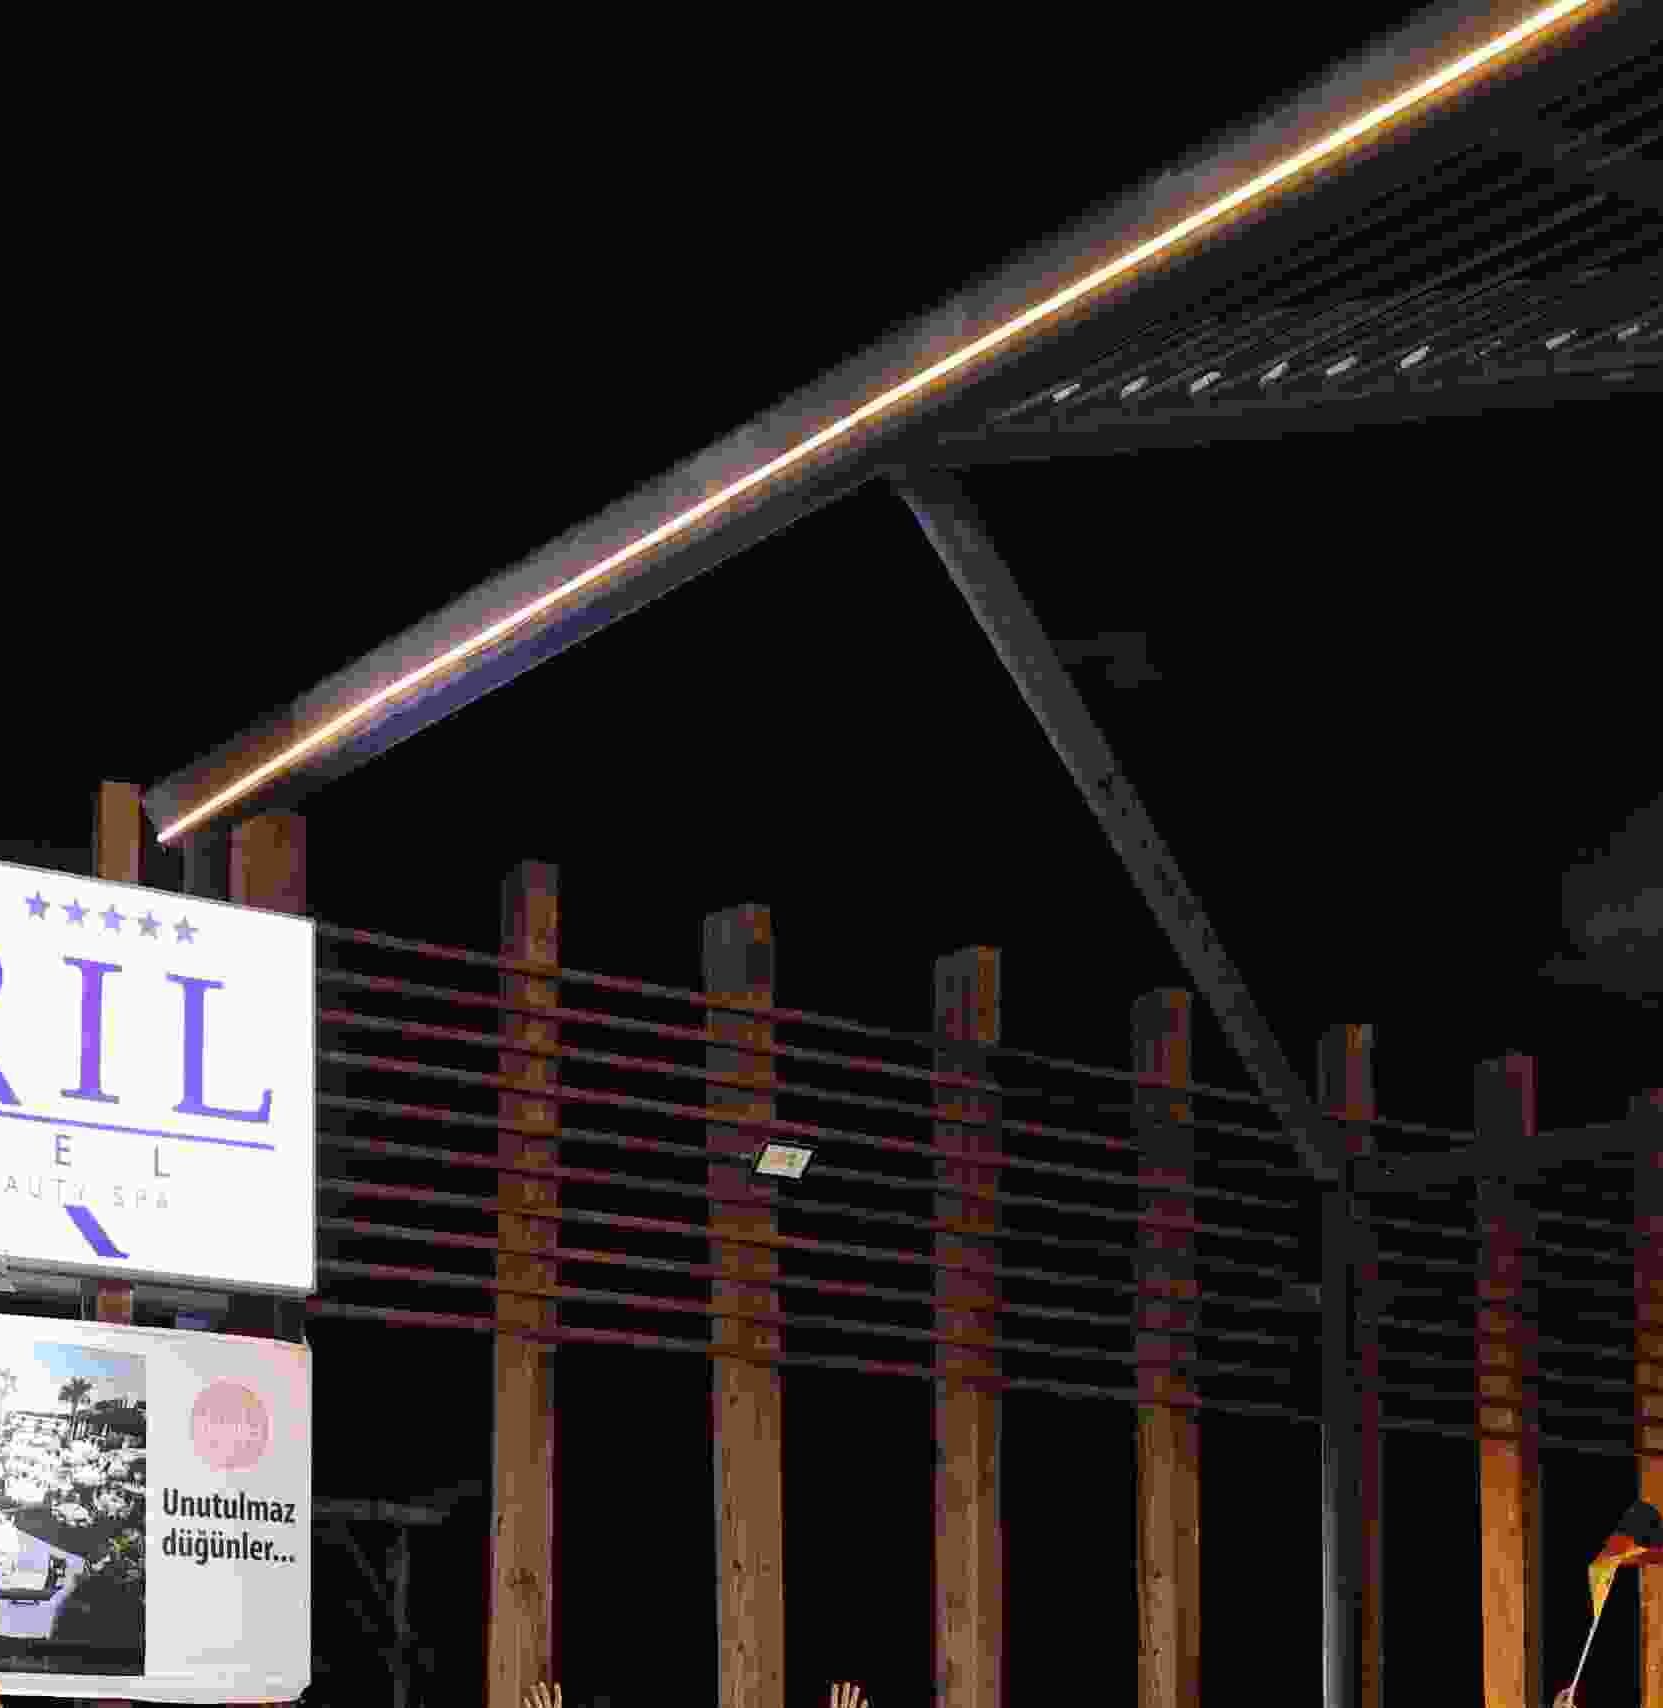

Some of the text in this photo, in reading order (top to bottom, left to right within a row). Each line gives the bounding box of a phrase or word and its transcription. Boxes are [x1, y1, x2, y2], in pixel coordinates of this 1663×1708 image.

[114, 1185, 168, 1208] SPA
[162, 1487, 295, 1523] Unutulmaz
[162, 1527, 295, 1565] düğünler...
